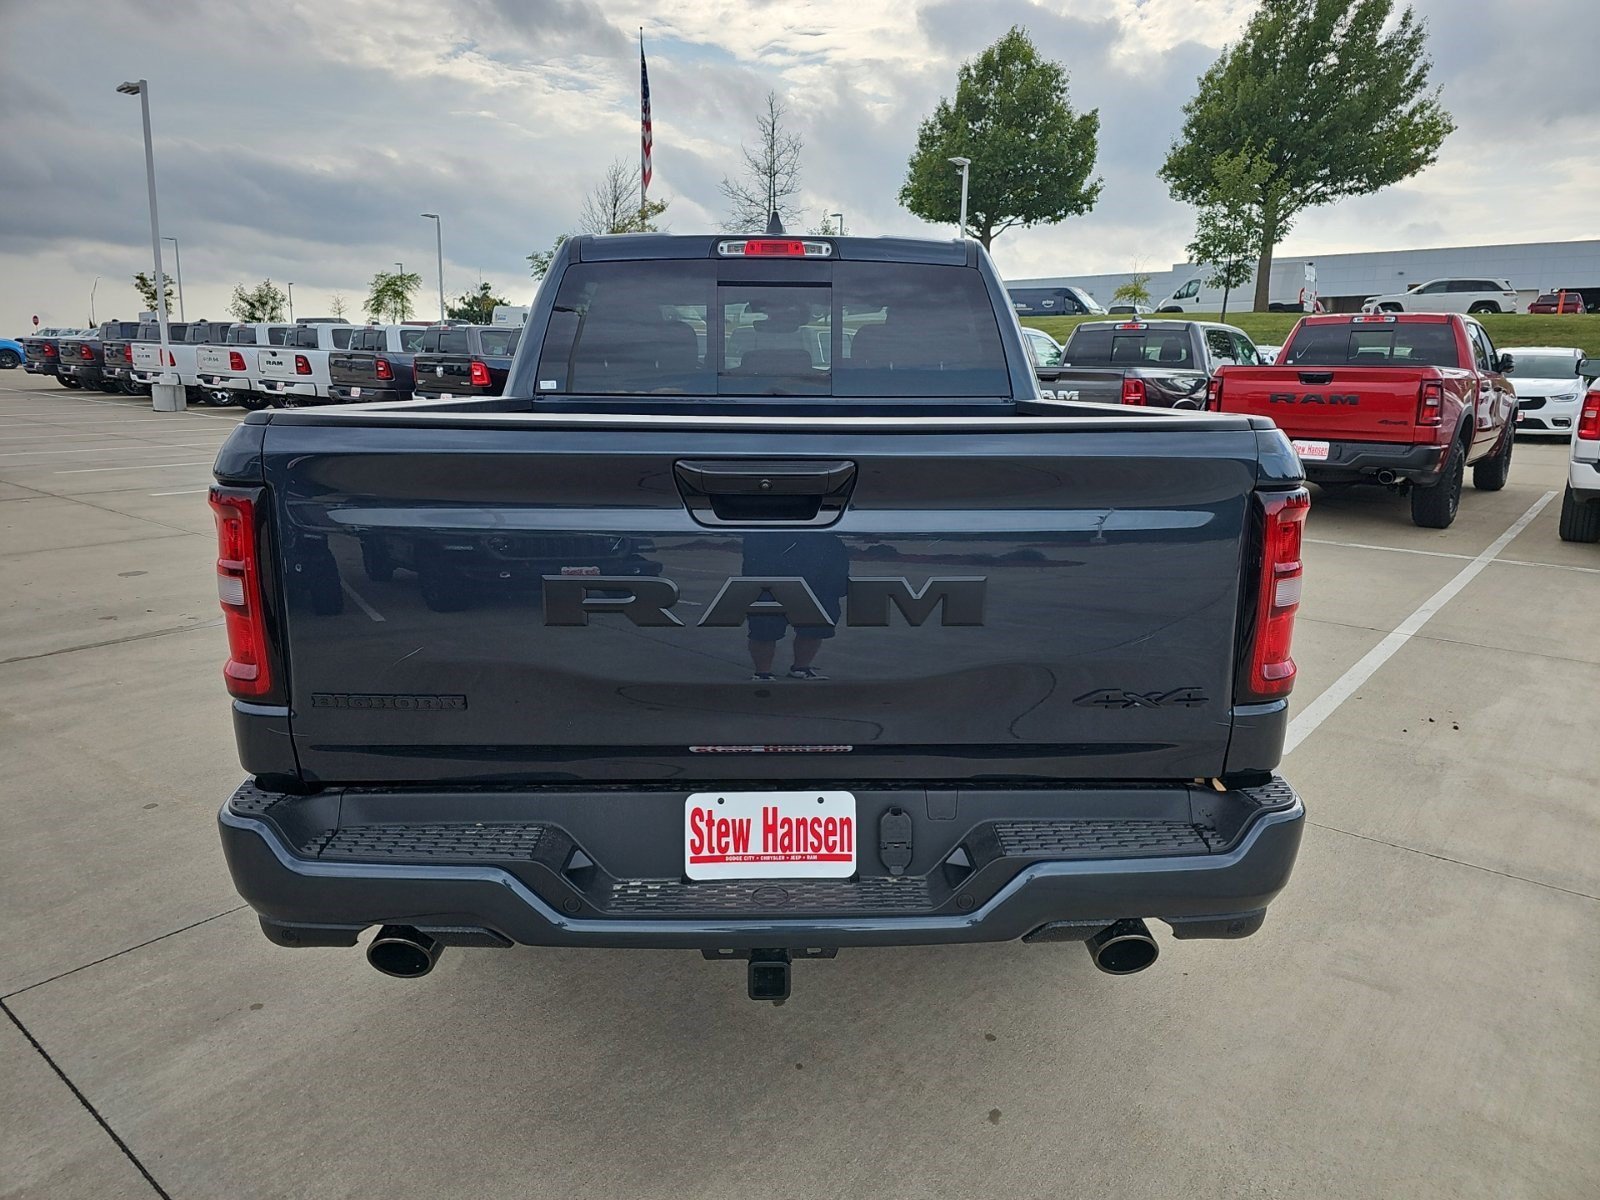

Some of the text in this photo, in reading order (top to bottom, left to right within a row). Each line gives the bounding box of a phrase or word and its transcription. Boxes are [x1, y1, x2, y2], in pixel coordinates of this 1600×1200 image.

[1040, 389, 1080, 400] AM
[1269, 392, 1360, 406] RAM
[1307, 444, 1328, 455] Hansen
[541, 574, 988, 627] RAM
[690, 806, 852, 855] Stew Hansen
